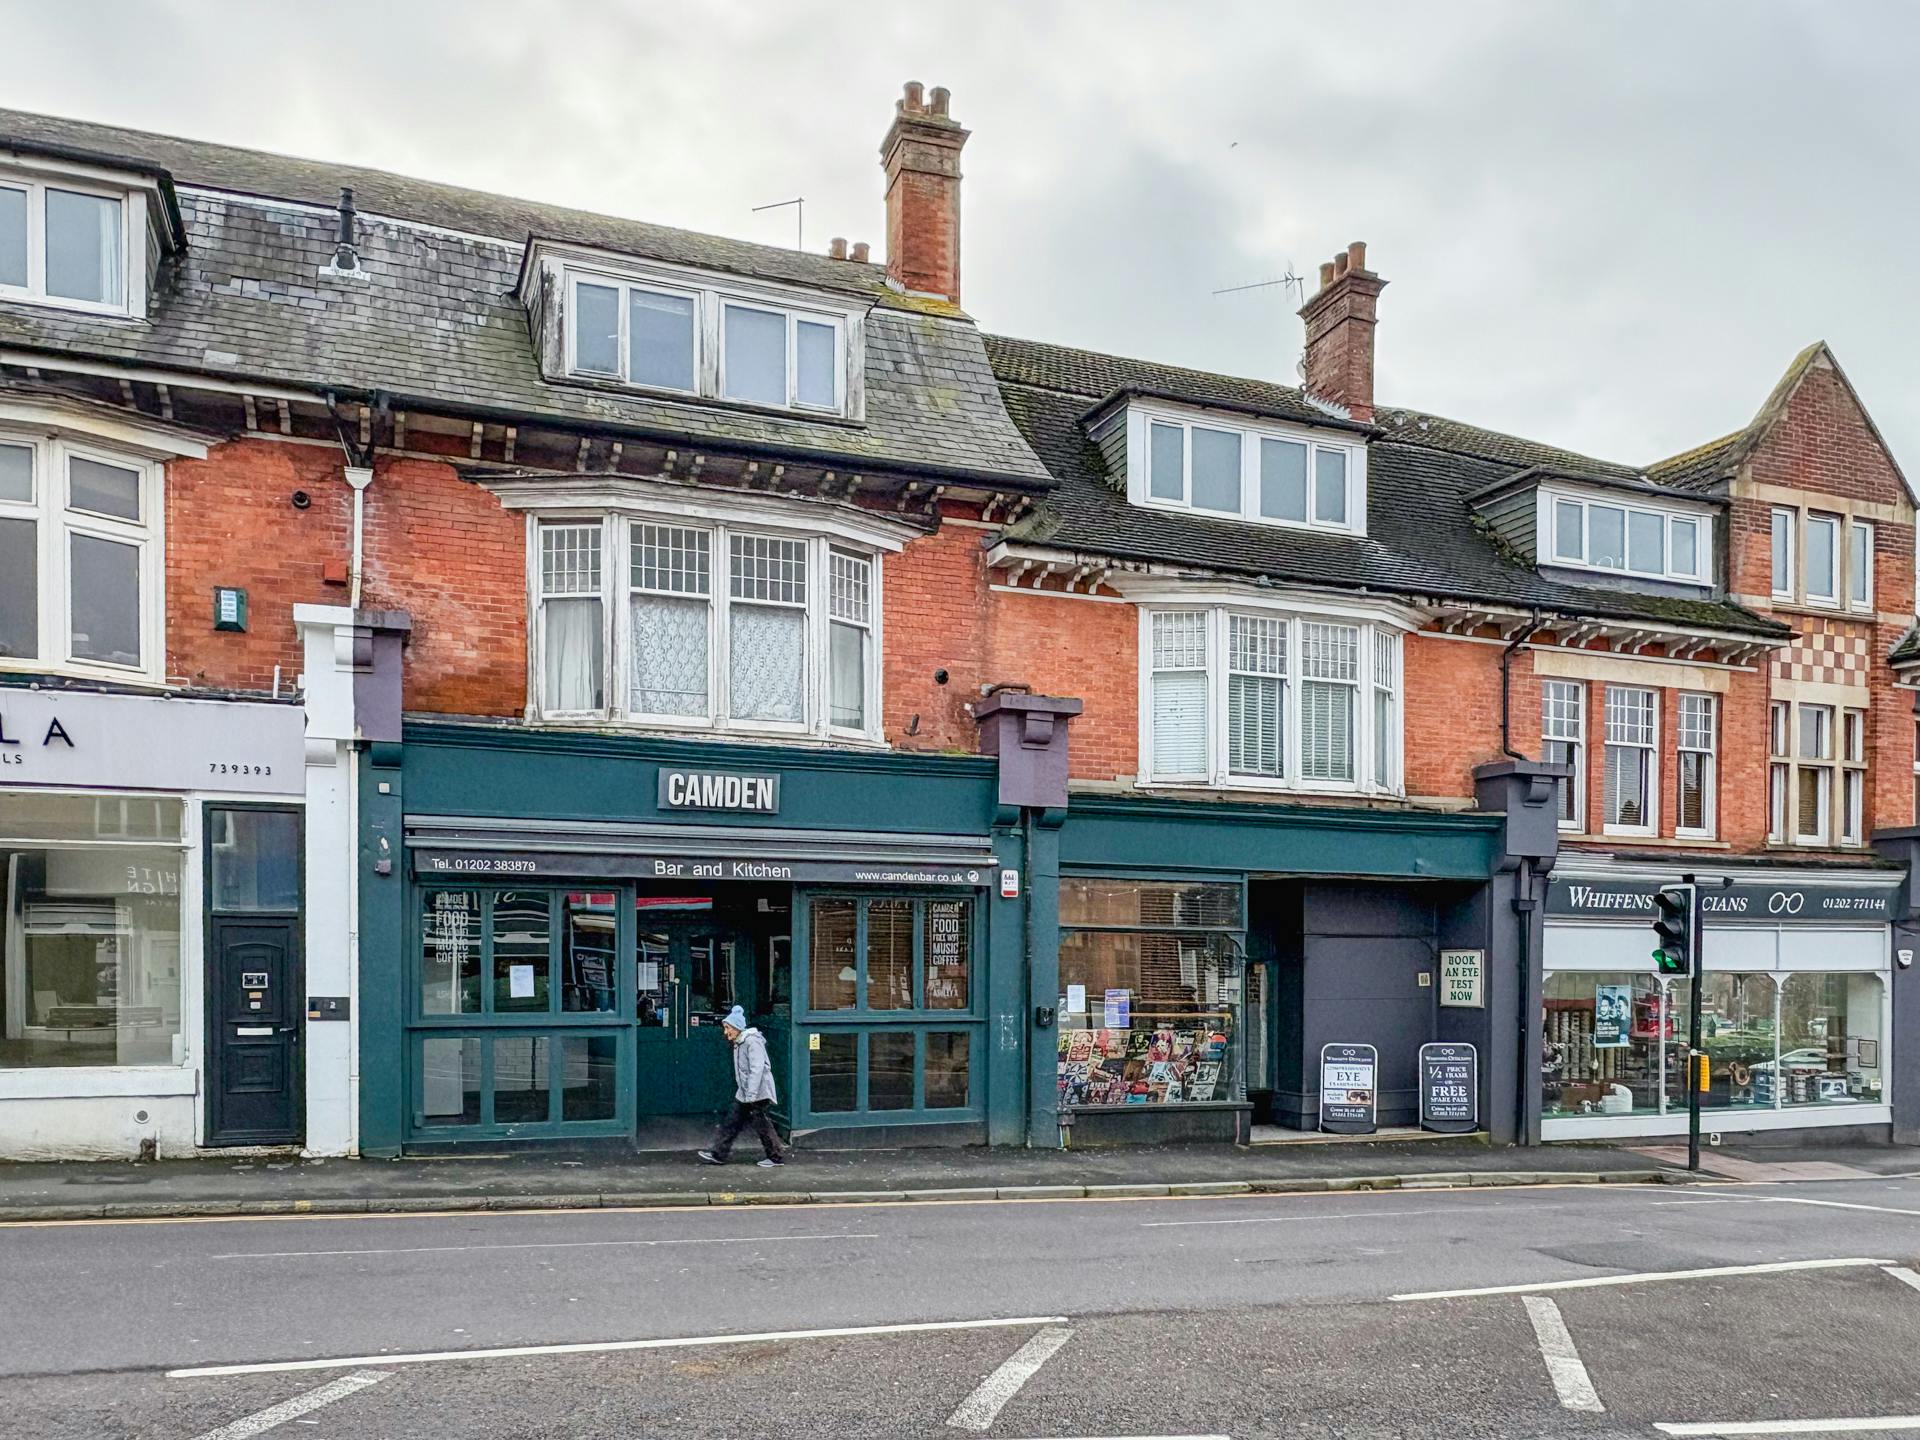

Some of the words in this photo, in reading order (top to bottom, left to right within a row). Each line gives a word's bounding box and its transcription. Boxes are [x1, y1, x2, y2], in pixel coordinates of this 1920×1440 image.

[209, 763, 272, 776] 739393
[668, 773, 773, 810] CAMDEN
[431, 858, 453, 869] Tel.
[455, 859, 491, 871] 01202
[494, 861, 536, 872] 383879
[654, 860, 684, 876] Bar
[693, 862, 723, 877] and
[733, 862, 792, 879] Kitchen
[855, 870, 963, 883] www.camdenbar.co.uk
[1702, 896, 1749, 912] CIANS
[1822, 897, 1851, 909] 01202
[1853, 898, 1886, 910] 771144
[436, 910, 469, 927] FOOD
[932, 918, 959, 933] FOOD
[932, 942, 959, 955] MUSIC
[932, 954, 959, 966] COFFEE
[1448, 955, 1476, 966] BOOK
[1444, 967, 1459, 977] AN
[1461, 967, 1480, 977] EYE
[1449, 979, 1474, 989] TEST
[1450, 991, 1473, 1001] NOW
[1336, 1071, 1361, 1082] EYE
[1431, 1085, 1468, 1097] FREE
